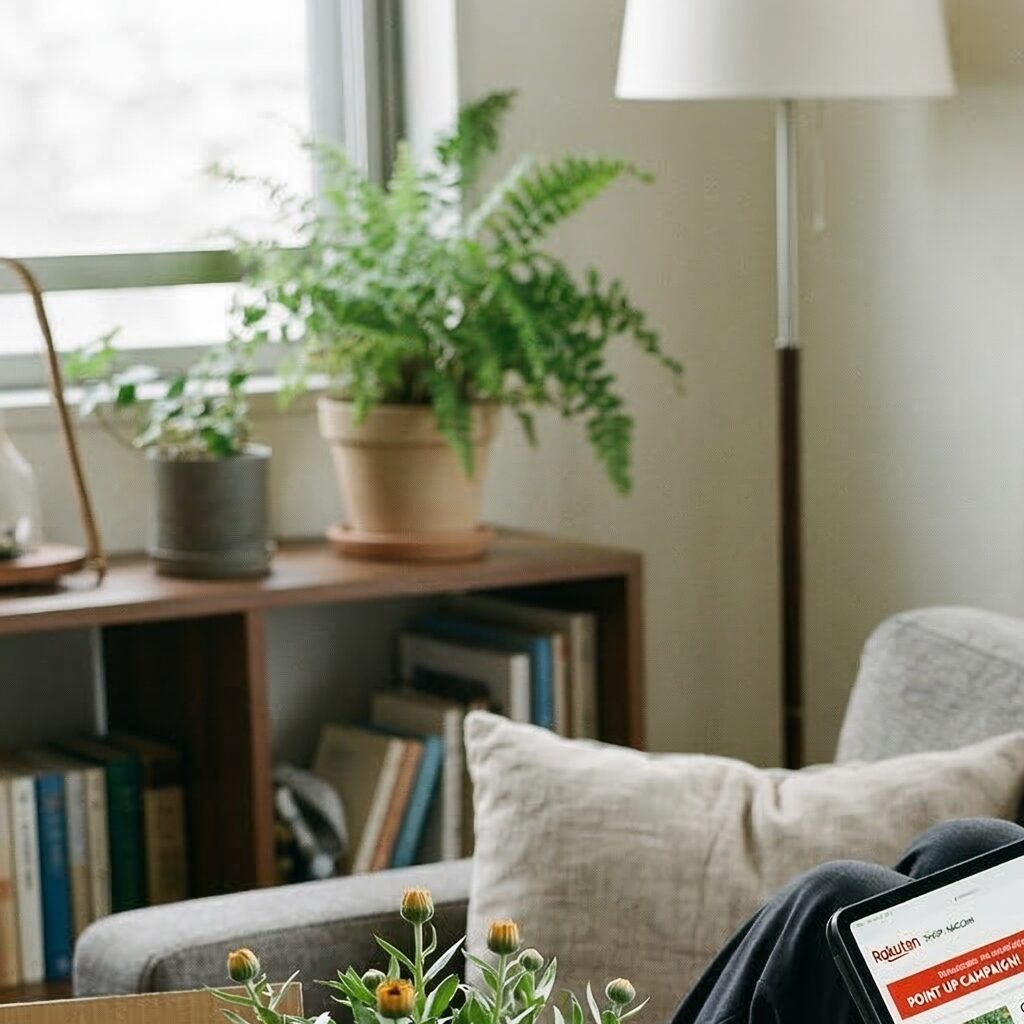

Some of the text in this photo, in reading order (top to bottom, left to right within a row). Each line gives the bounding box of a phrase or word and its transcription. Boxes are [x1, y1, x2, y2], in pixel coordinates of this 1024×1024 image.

[871, 937, 921, 964] Rakuten
[907, 985, 942, 1008] POINT
[941, 978, 960, 994] UP
